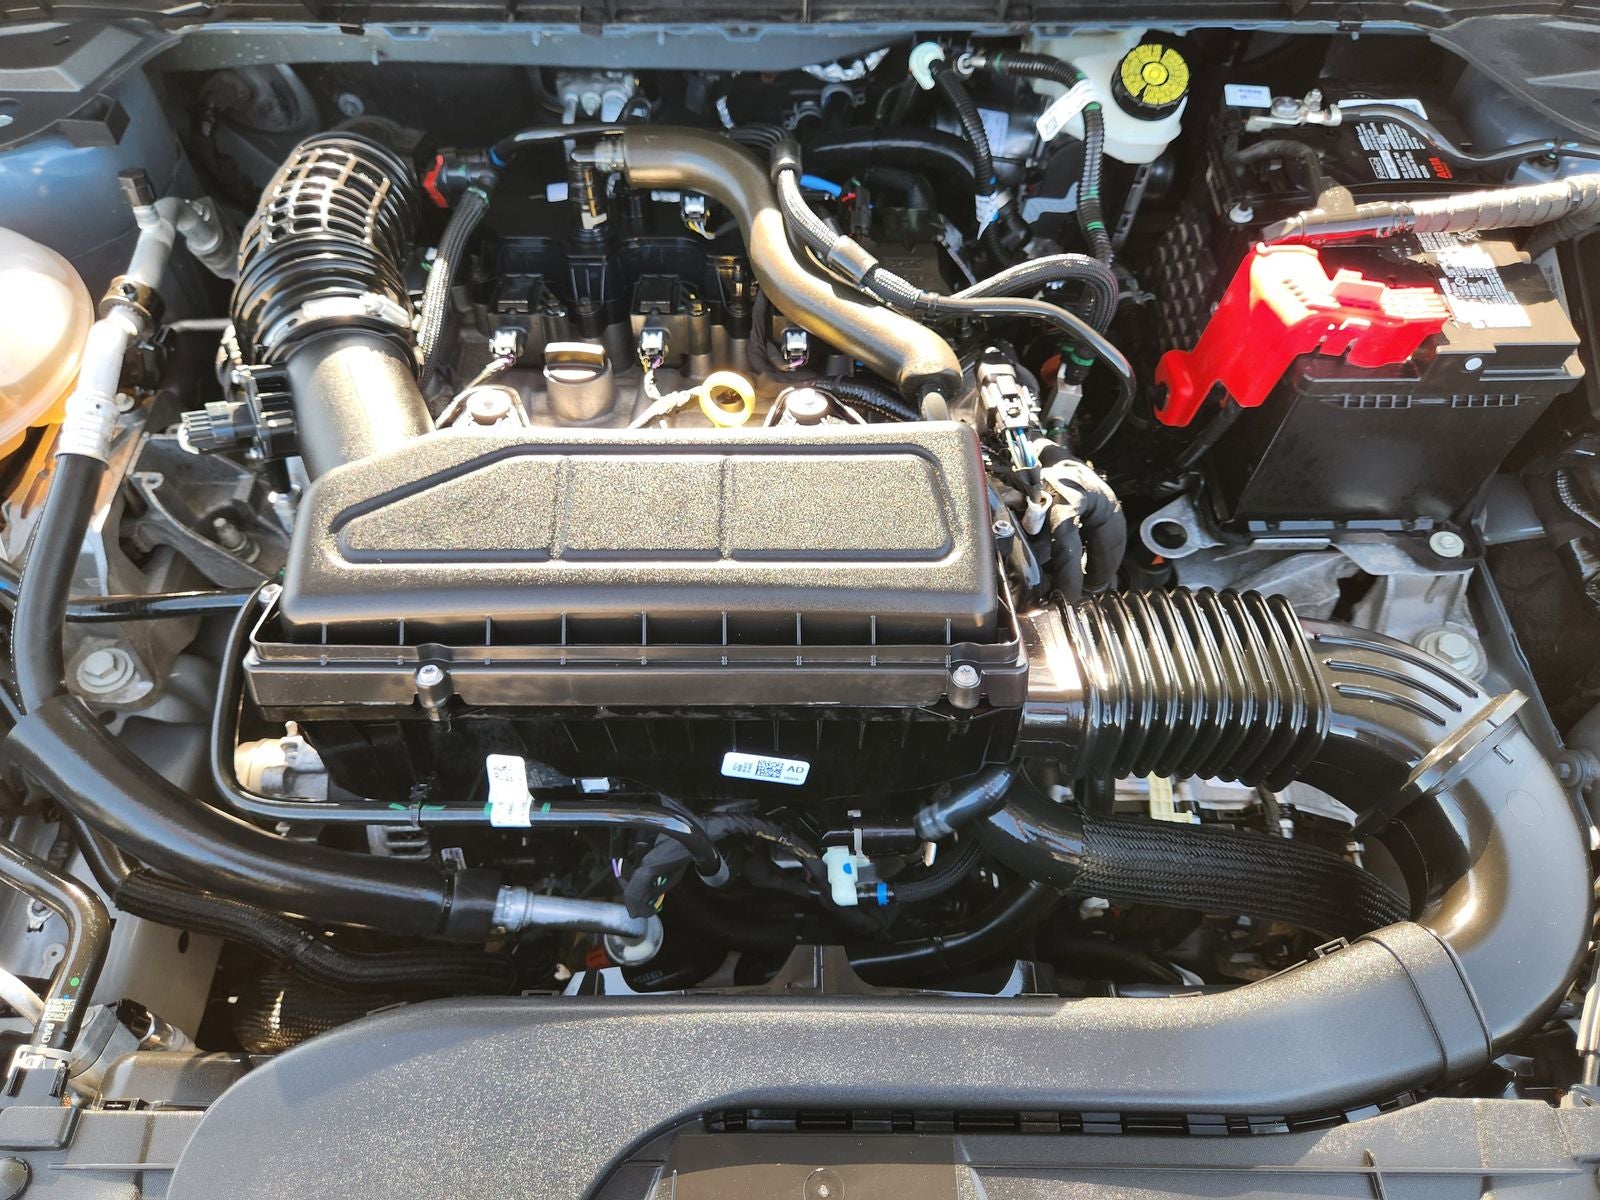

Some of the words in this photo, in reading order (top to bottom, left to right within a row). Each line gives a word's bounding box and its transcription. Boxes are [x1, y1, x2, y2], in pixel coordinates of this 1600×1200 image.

[1428, 156, 1449, 178] AGM
[786, 765, 805, 774] AD
[41, 1022, 55, 1043] RAD
